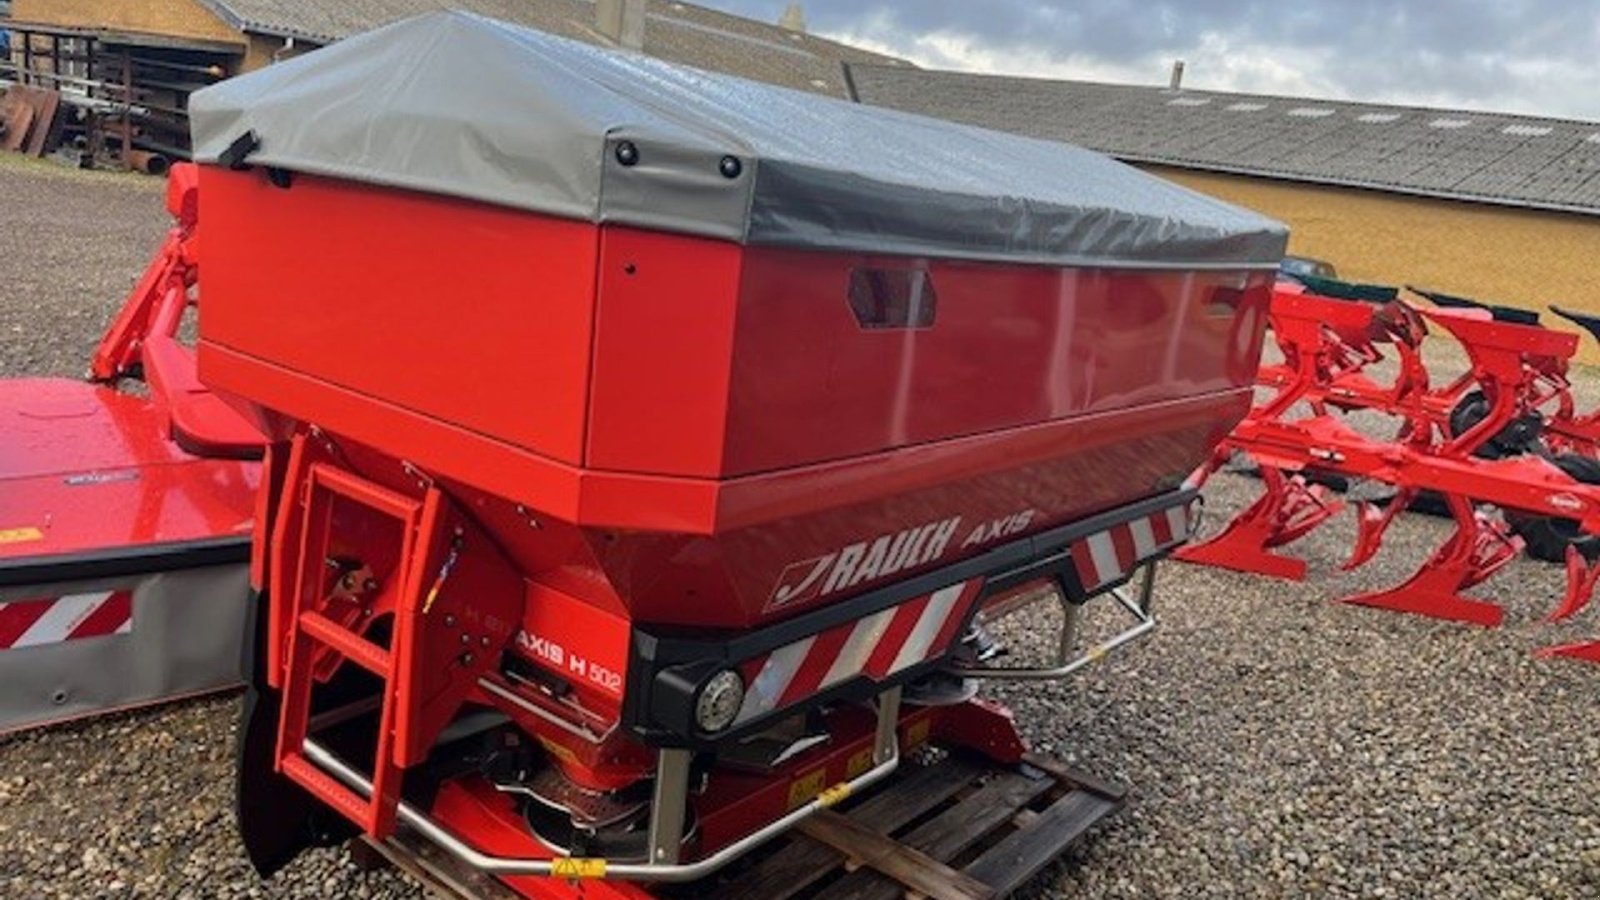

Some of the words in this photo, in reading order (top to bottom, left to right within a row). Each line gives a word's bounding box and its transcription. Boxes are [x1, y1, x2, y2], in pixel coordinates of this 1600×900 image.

[820, 515, 961, 596] RAUCH
[961, 509, 1035, 549] AXIS
[514, 629, 564, 666] AXIS
[569, 653, 586, 676] H
[589, 662, 622, 692] 502
